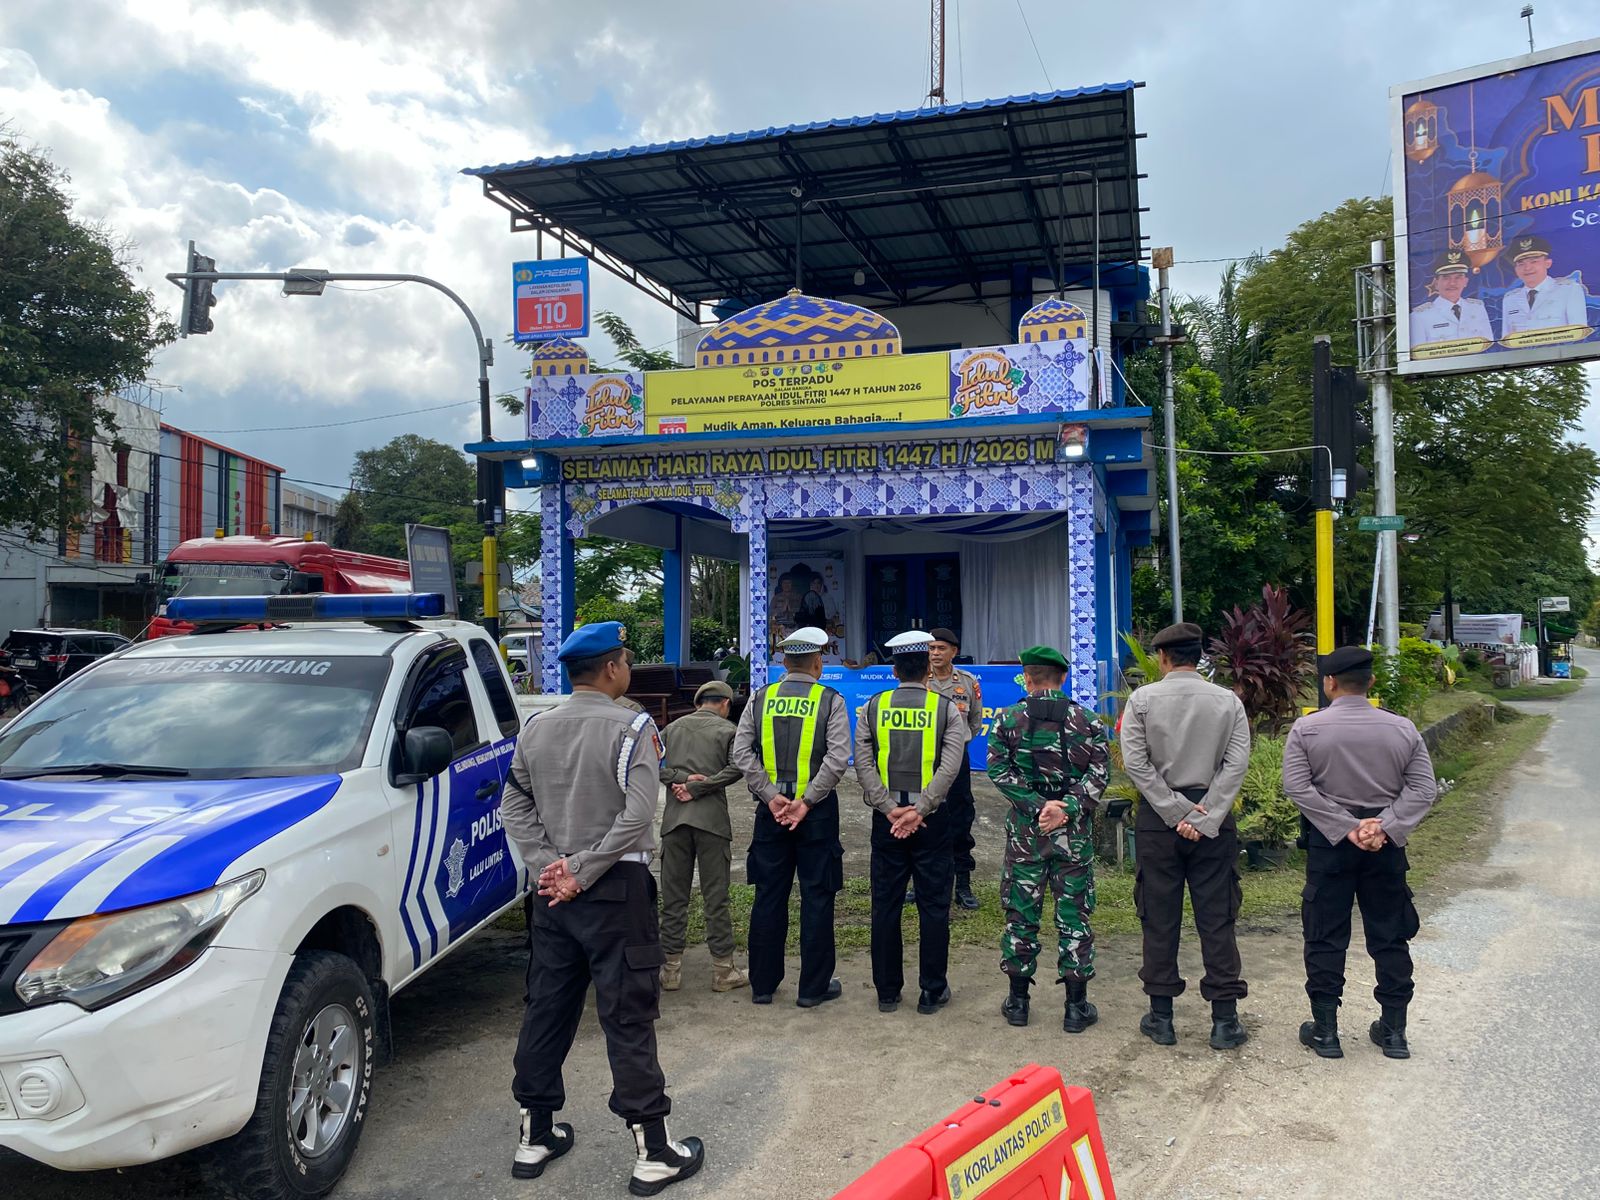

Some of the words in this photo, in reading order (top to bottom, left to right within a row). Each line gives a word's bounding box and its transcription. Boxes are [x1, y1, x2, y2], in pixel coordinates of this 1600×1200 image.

[1521, 188, 1572, 211] KONI
[1571, 205, 1600, 228] Se
[534, 267, 582, 278] PRESISI
[534, 301, 567, 325] 110
[753, 378, 776, 388] POS
[779, 374, 834, 387] TERPADU
[958, 360, 1012, 392] Idul
[586, 387, 632, 414] Idul
[671, 396, 725, 405] PELAYANAN
[728, 393, 777, 402] PERAYAAN
[780, 391, 801, 399] IDUL
[804, 390, 827, 398] FITRI
[830, 388, 851, 396] 1447
[854, 387, 860, 395] H
[863, 385, 896, 394] TAHUN
[899, 382, 922, 391] 2026
[760, 399, 791, 407] POLRES
[792, 398, 826, 406] SINTANG
[956, 381, 1018, 415] Fitri
[583, 406, 637, 435] Fitri
[703, 421, 738, 431] Mudik
[562, 457, 652, 480] SELAMAT
[657, 455, 706, 477] HARI
[711, 453, 764, 473] RAYA
[769, 450, 817, 471] IDUL
[823, 447, 877, 468] FITRI
[885, 445, 934, 465] 1447
[941, 444, 957, 464] H
[975, 441, 1028, 462] 2026
[1036, 440, 1055, 459] M
[597, 488, 632, 499] SELAMAT
[633, 487, 651, 498] HARI
[653, 486, 673, 497] RAYA
[675, 485, 692, 496] IDUL
[694, 484, 714, 496] FITRI
[223, 658, 332, 676] SINTANG
[766, 698, 815, 716] POLISI
[881, 710, 932, 729] POLISI
[471, 807, 504, 847] POLIS
[469, 860, 484, 881] LALU
[484, 849, 503, 871] LINTAS
[355, 996, 369, 1018] GT
[353, 1026, 373, 1123] RADIAL
[963, 1130, 1025, 1188] KORLANTAS
[1025, 1110, 1051, 1143] POLRI
